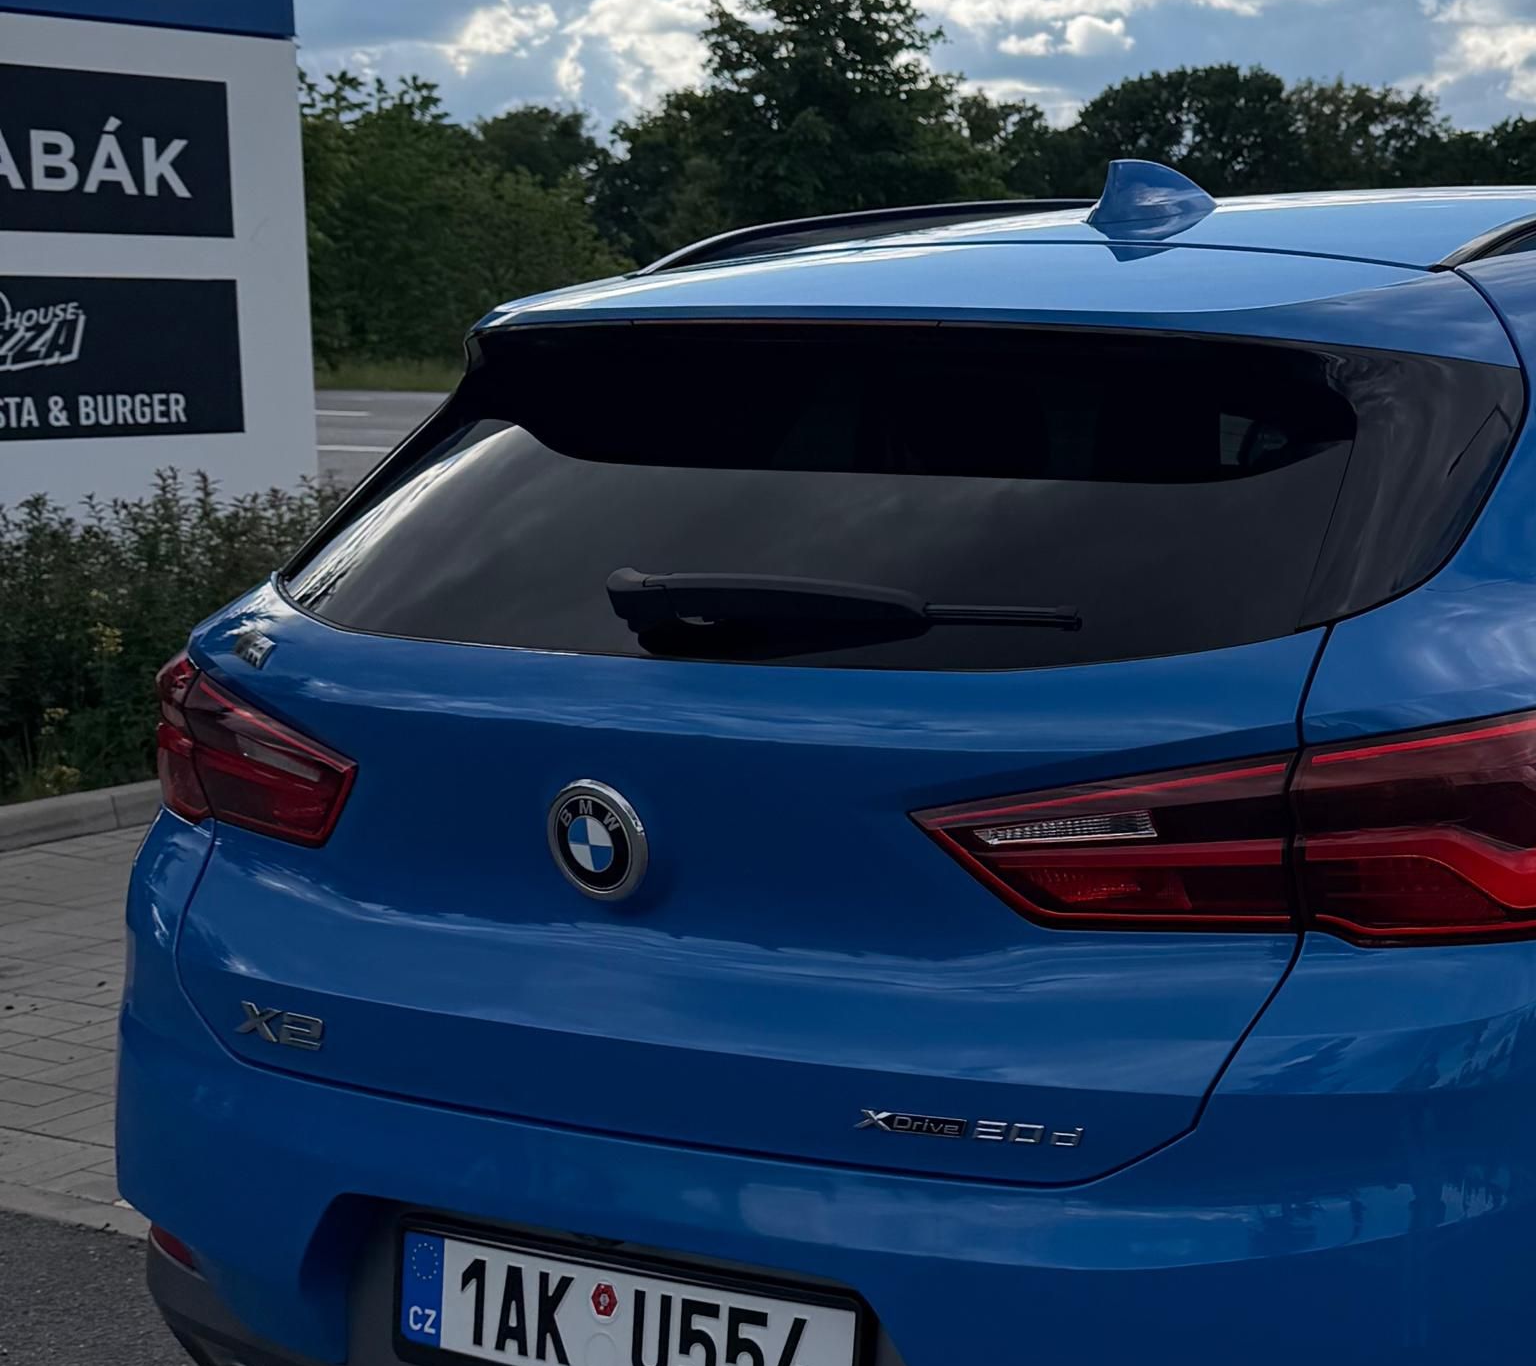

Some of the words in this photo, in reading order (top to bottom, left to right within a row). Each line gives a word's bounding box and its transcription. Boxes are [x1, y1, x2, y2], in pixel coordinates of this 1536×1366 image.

[4, 301, 80, 331] HOUSE
[48, 395, 72, 427] &
[78, 392, 188, 426] BURGER
[560, 799, 621, 832] BMW
[408, 1305, 437, 1335] CZ
[460, 1257, 576, 1366] 1AK
